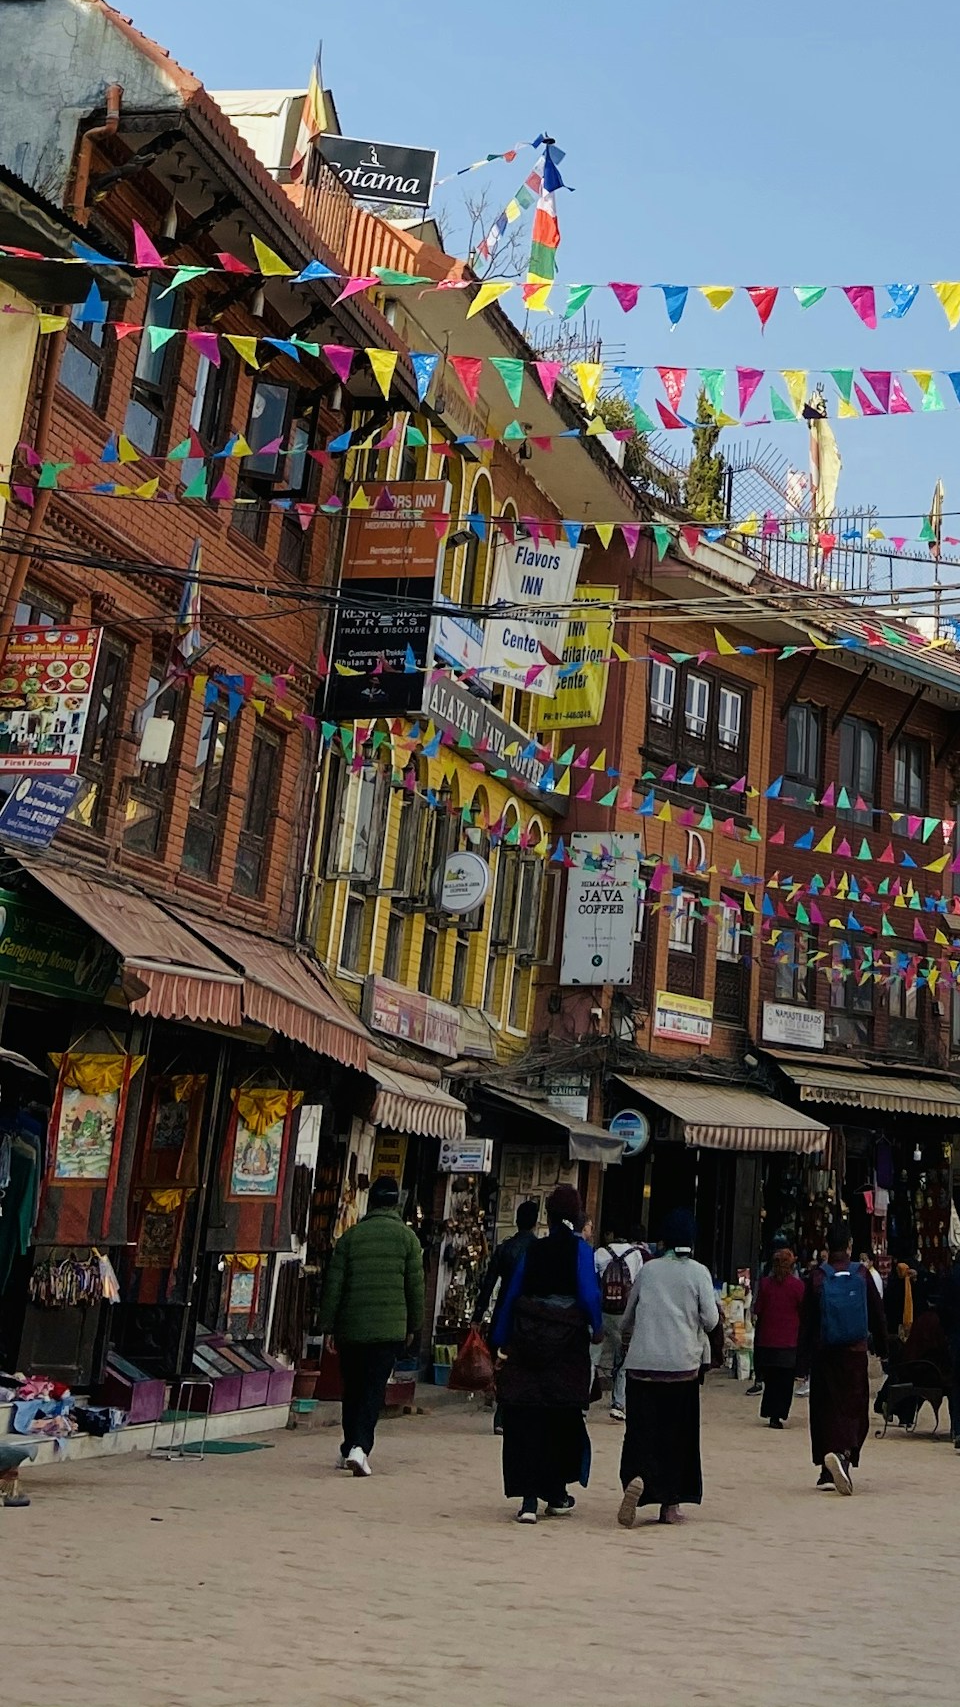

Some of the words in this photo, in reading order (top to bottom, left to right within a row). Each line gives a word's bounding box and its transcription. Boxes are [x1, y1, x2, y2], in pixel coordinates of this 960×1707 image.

[415, 494, 437, 508] INN
[371, 510, 395, 519] GUEST
[515, 546, 561, 570] Flavors
[520, 575, 544, 596] INN
[382, 626, 426, 634] DISCOVER
[567, 621, 587, 637] INN
[502, 627, 541, 653] Center
[579, 889, 624, 903] JAVA
[577, 904, 624, 916] COFFEE
[47, 950, 77, 973] Momo
